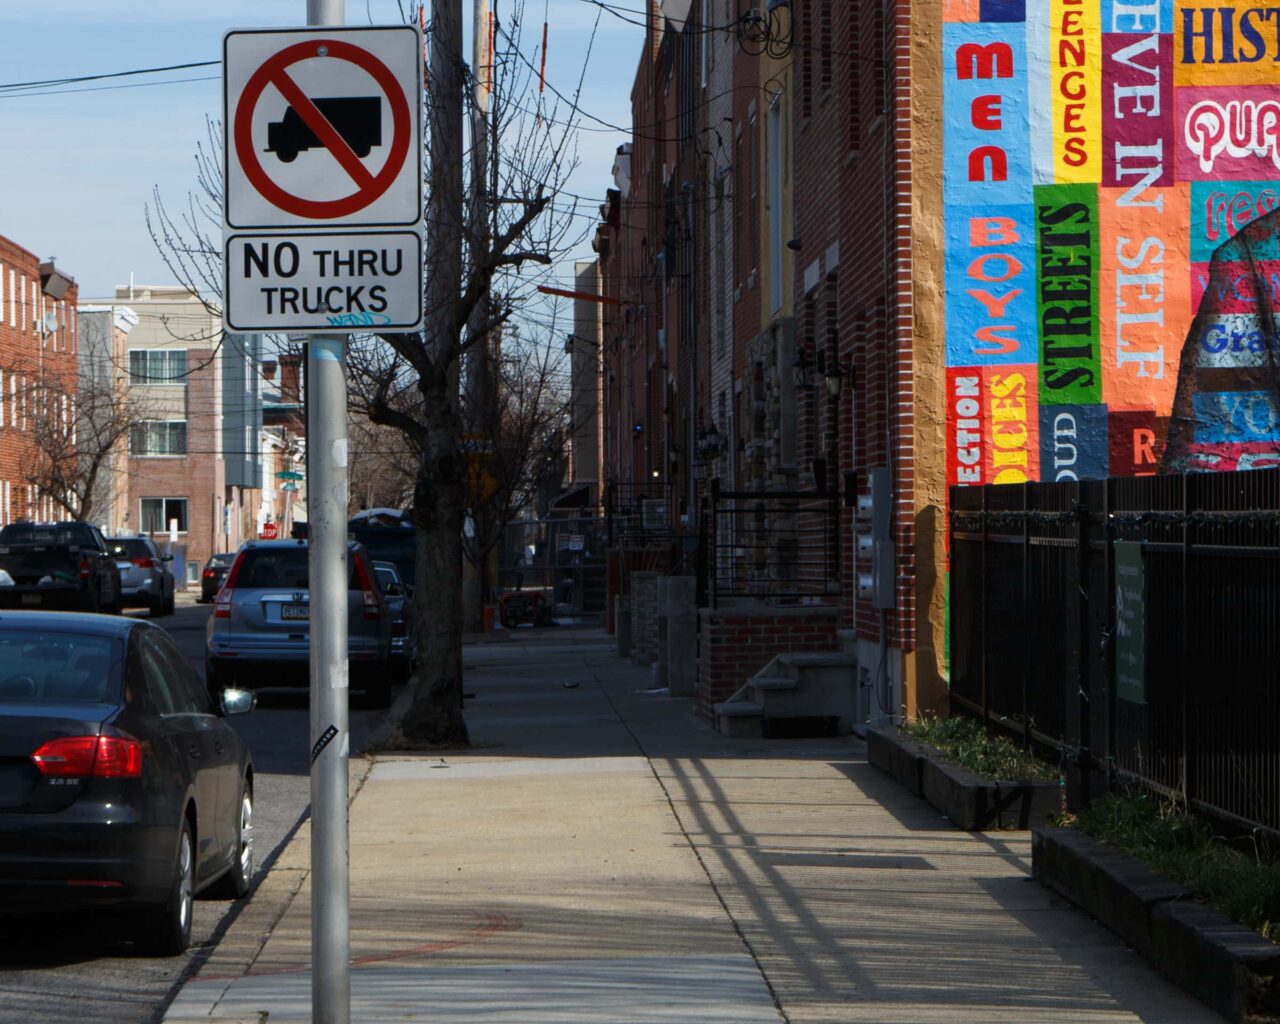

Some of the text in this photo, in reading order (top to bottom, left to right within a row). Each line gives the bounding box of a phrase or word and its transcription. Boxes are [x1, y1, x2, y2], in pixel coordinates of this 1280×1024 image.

[1115, 139, 1164, 214] IN
[243, 241, 403, 279] NO THRU
[260, 285, 388, 315] TRUCKS
[965, 216, 1024, 356] BOYS
[1038, 202, 1096, 390] STREETS
[1115, 235, 1165, 380] SELF
[955, 376, 982, 487] ECTION
